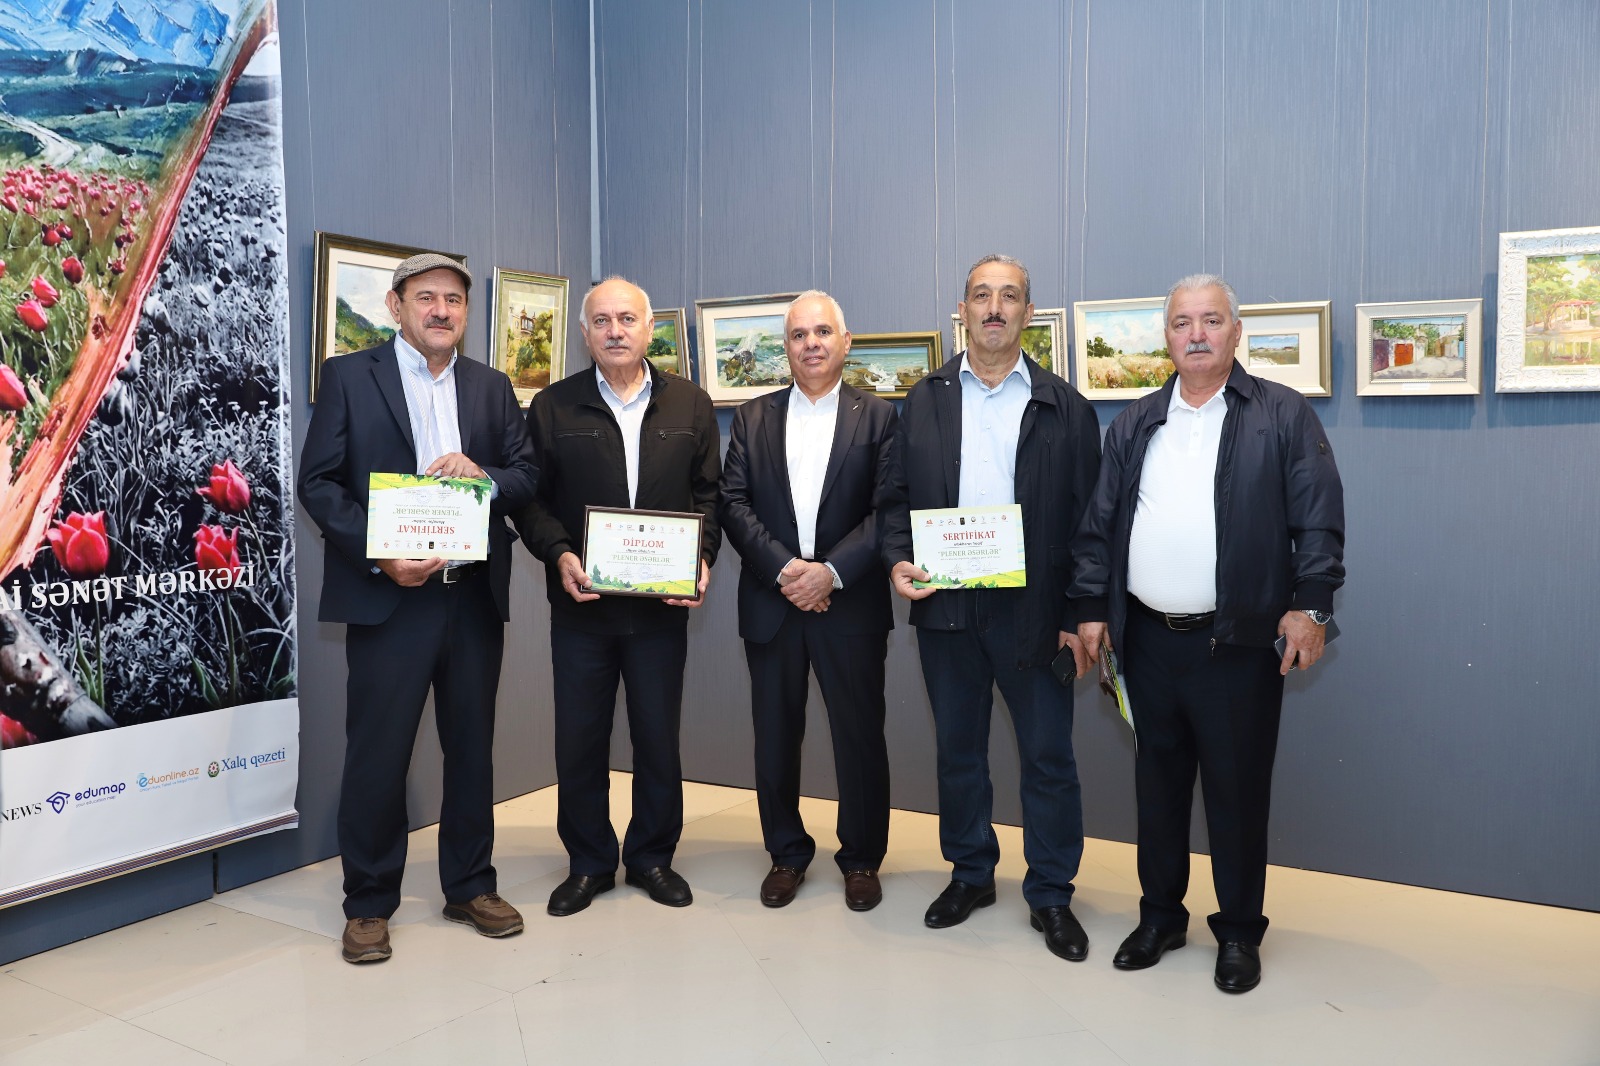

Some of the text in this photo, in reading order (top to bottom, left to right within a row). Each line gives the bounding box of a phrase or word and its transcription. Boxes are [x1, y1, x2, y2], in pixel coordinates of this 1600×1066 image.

[397, 524, 455, 535] SERTİFİKAT
[943, 529, 996, 541] SERTİFİKAT
[622, 537, 665, 549] DİPLOM
[31, 576, 129, 609] SƏNƏT
[134, 560, 255, 598] MƏRKƏZİ
[221, 747, 285, 772] Xalq qəzeti
[138, 767, 200, 788] eduonline.az
[75, 782, 126, 801] edumap
